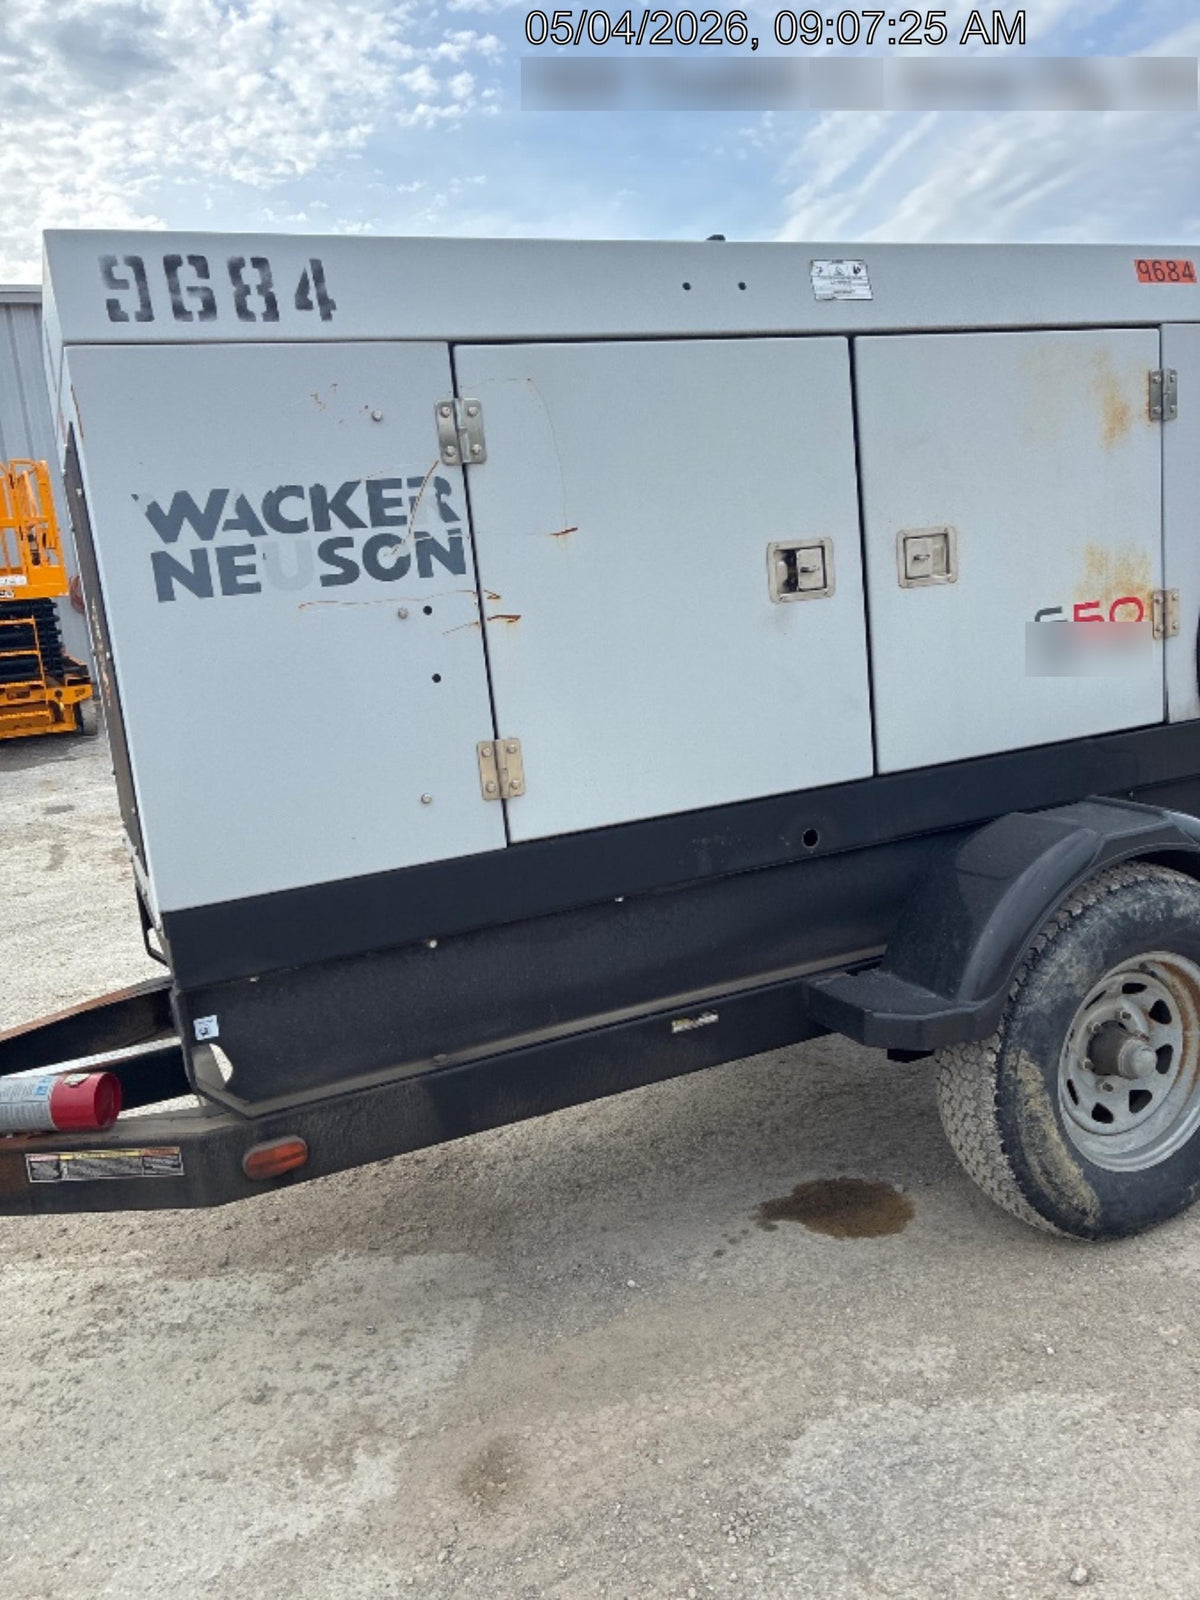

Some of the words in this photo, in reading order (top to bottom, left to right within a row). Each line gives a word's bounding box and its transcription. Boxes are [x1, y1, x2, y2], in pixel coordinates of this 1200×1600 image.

[99, 254, 337, 322] 9684
[1137, 260, 1195, 282] 9684
[131, 475, 461, 544] WACKER
[150, 527, 467, 603] NEUSON
